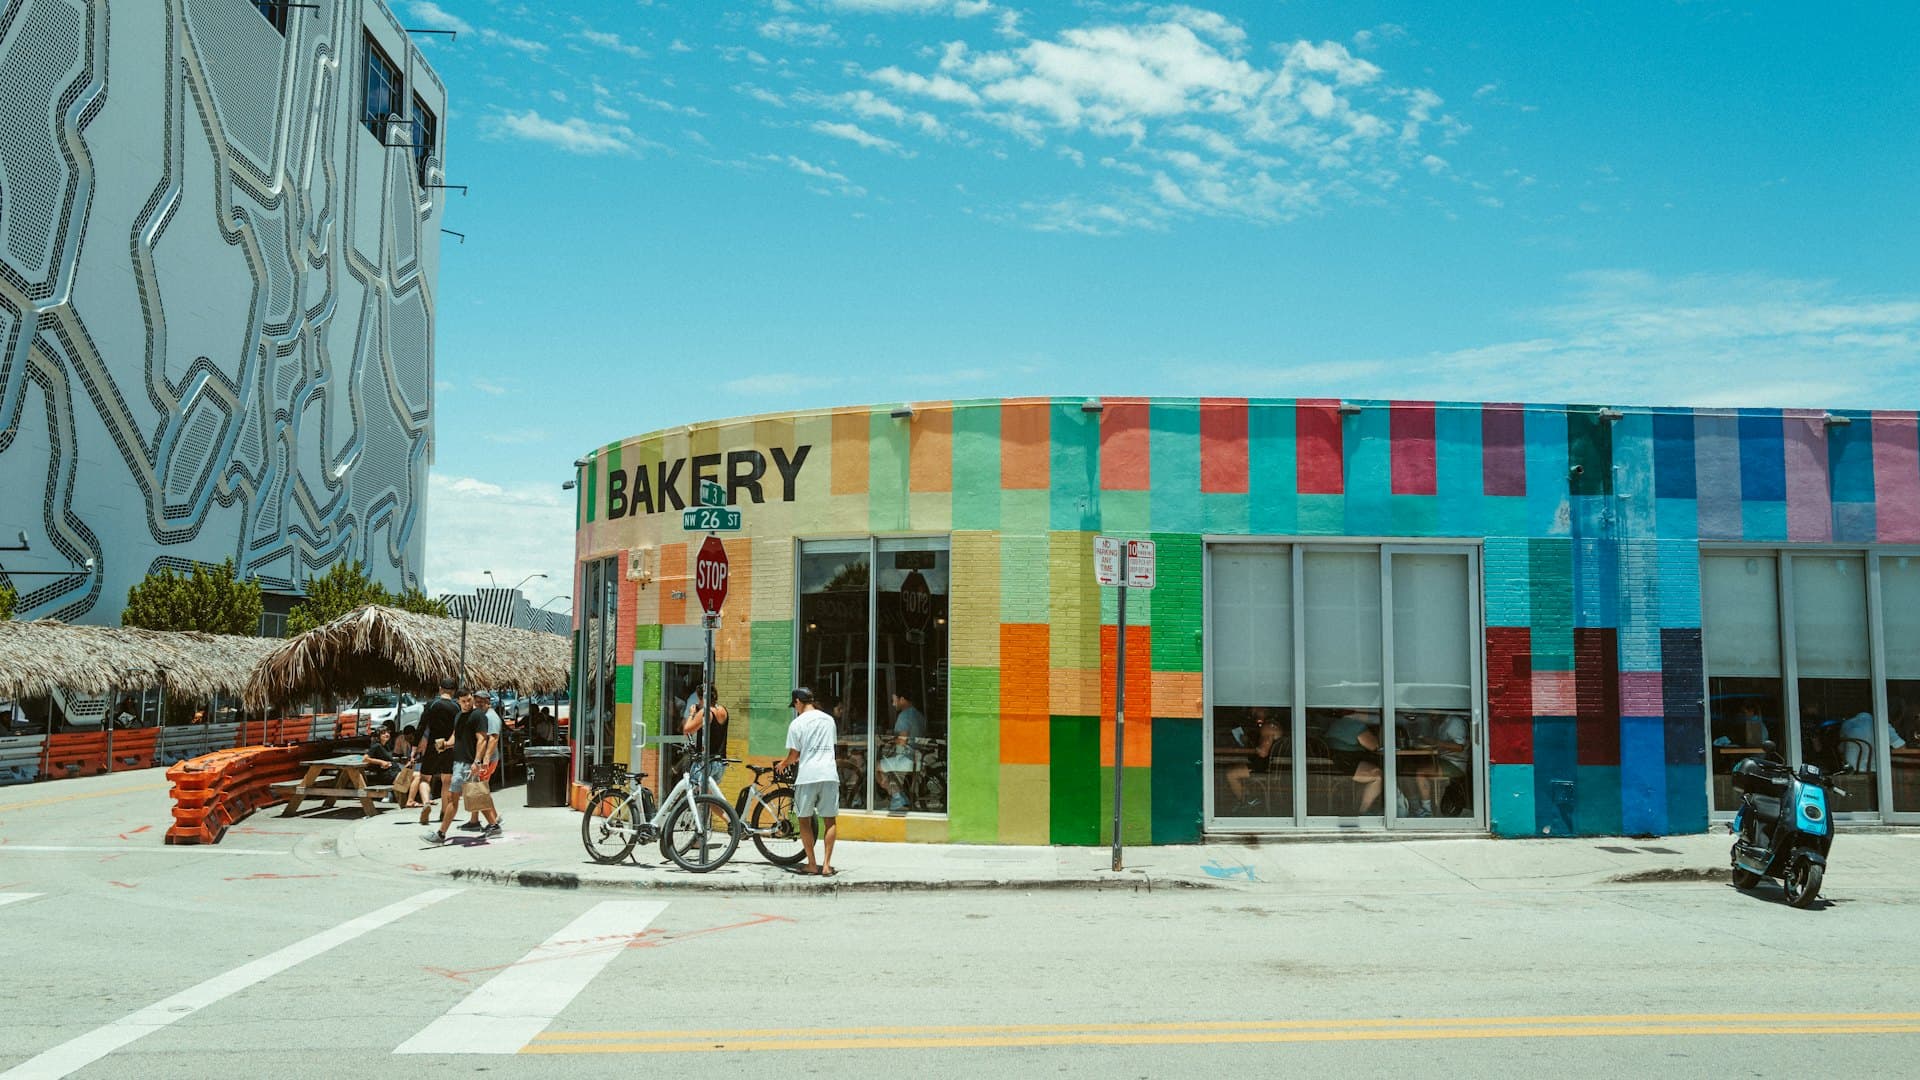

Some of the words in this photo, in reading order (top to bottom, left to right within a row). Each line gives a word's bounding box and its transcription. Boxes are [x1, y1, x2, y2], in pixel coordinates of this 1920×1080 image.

[608, 445, 812, 520] BAKERY
[712, 487, 718, 504] 3
[684, 514, 696, 527] NW
[701, 511, 720, 528] 26
[728, 514, 739, 526] ST
[1128, 544, 1137, 556] 10
[697, 560, 727, 591] STOP
